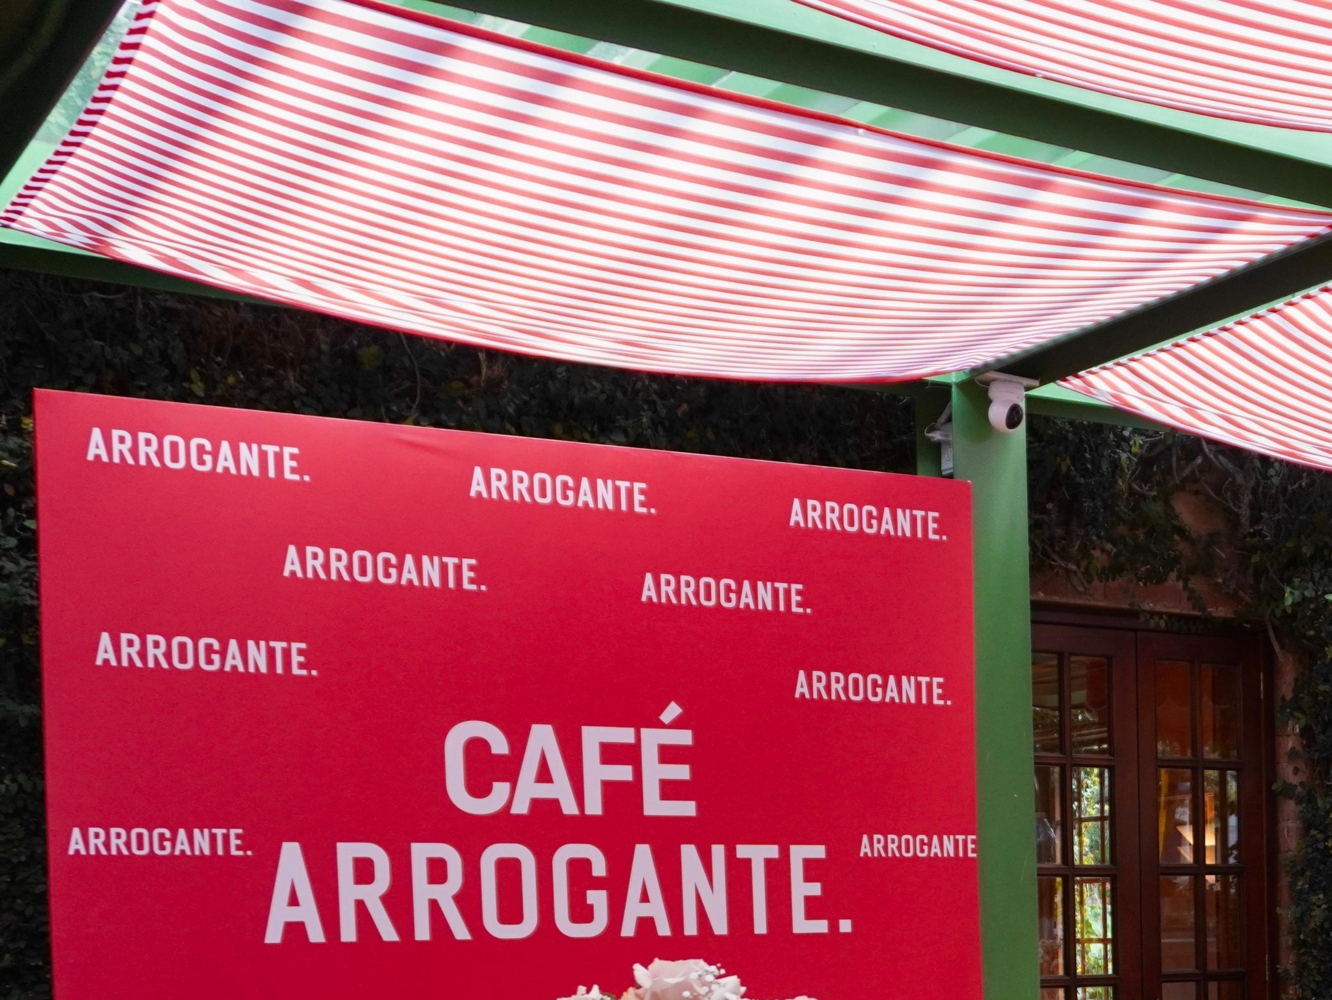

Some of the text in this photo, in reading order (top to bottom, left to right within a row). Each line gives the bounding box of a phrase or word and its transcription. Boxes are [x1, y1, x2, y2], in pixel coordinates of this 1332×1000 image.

[86, 427, 310, 481] ARROGANTE.
[470, 466, 656, 513] ARROGANTE.
[790, 498, 947, 540] ARROGANTE.
[283, 545, 487, 591] ARROGANTE.
[642, 573, 811, 613] ARROGANTE.
[96, 632, 317, 676] ARROGANTE.
[795, 670, 951, 705] ARROGANTE.
[444, 701, 697, 816] CAFÉ
[69, 827, 252, 855] ARROGANTE.
[265, 842, 852, 943] ARROGANTE.
